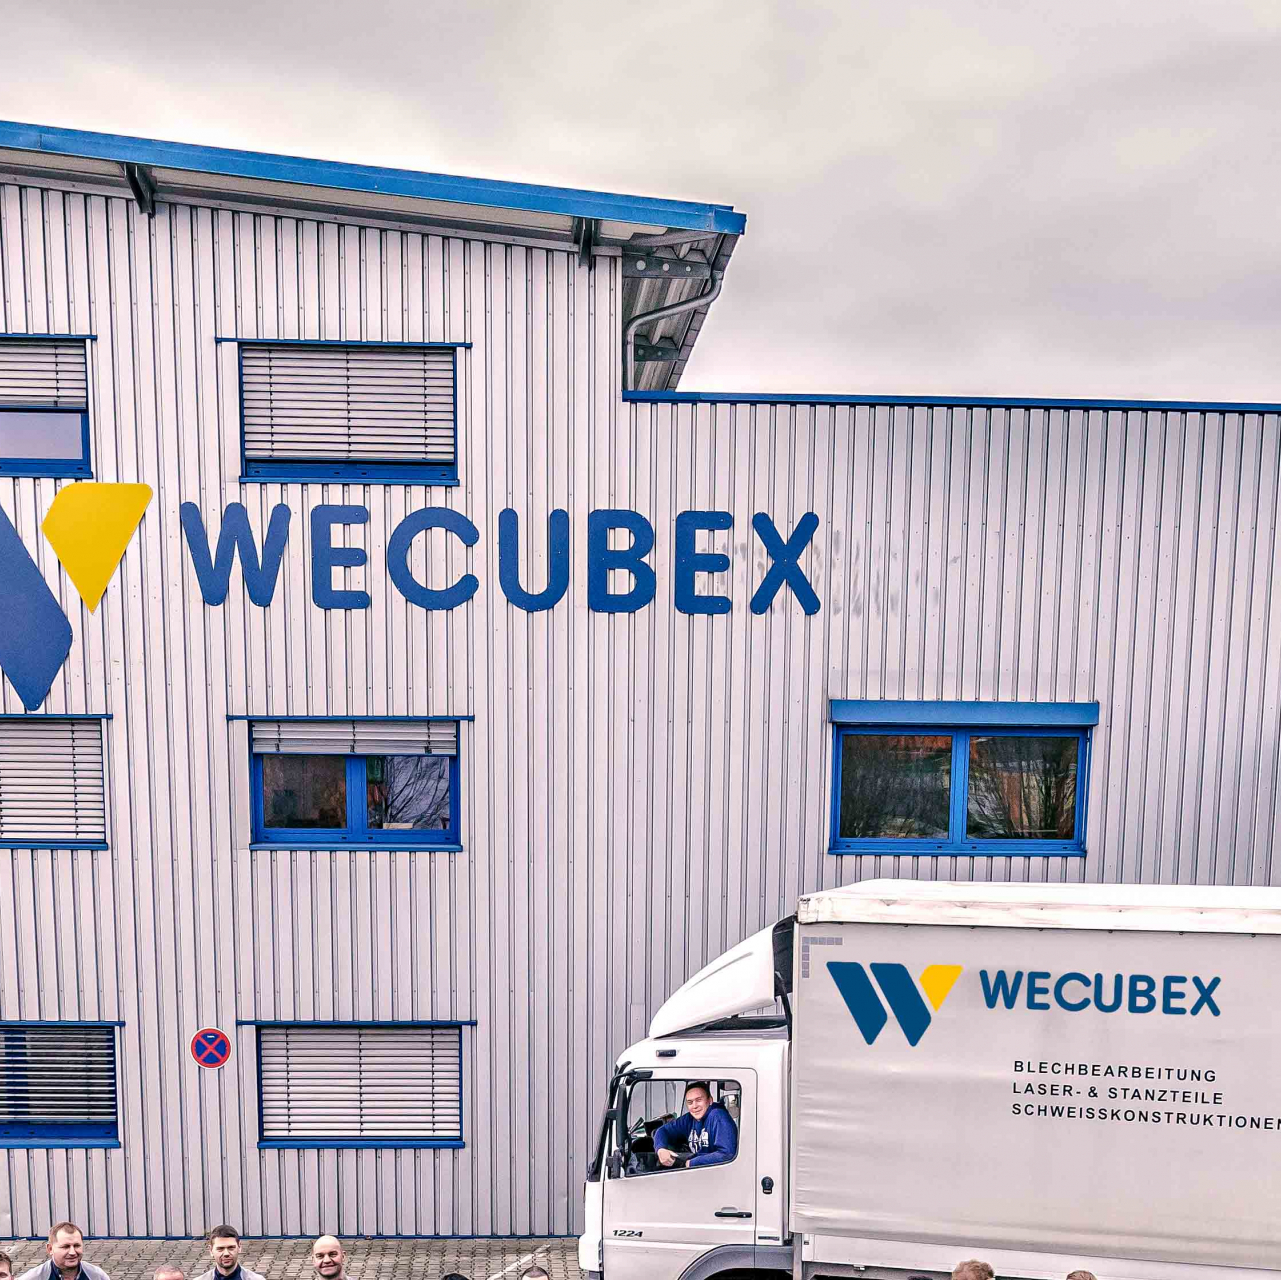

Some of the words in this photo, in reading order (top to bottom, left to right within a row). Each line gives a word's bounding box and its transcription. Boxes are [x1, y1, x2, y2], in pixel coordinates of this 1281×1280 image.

[179, 502, 820, 616] WECUBEX
[979, 969, 1221, 1017] WECUBEX
[1014, 1060, 1216, 1082] BLECHBEARBEITUNG
[1013, 1082, 1081, 1097] LASER-
[1088, 1086, 1099, 1098] &
[1108, 1087, 1223, 1105] STANZTEILE
[612, 1229, 644, 1238] 1224
